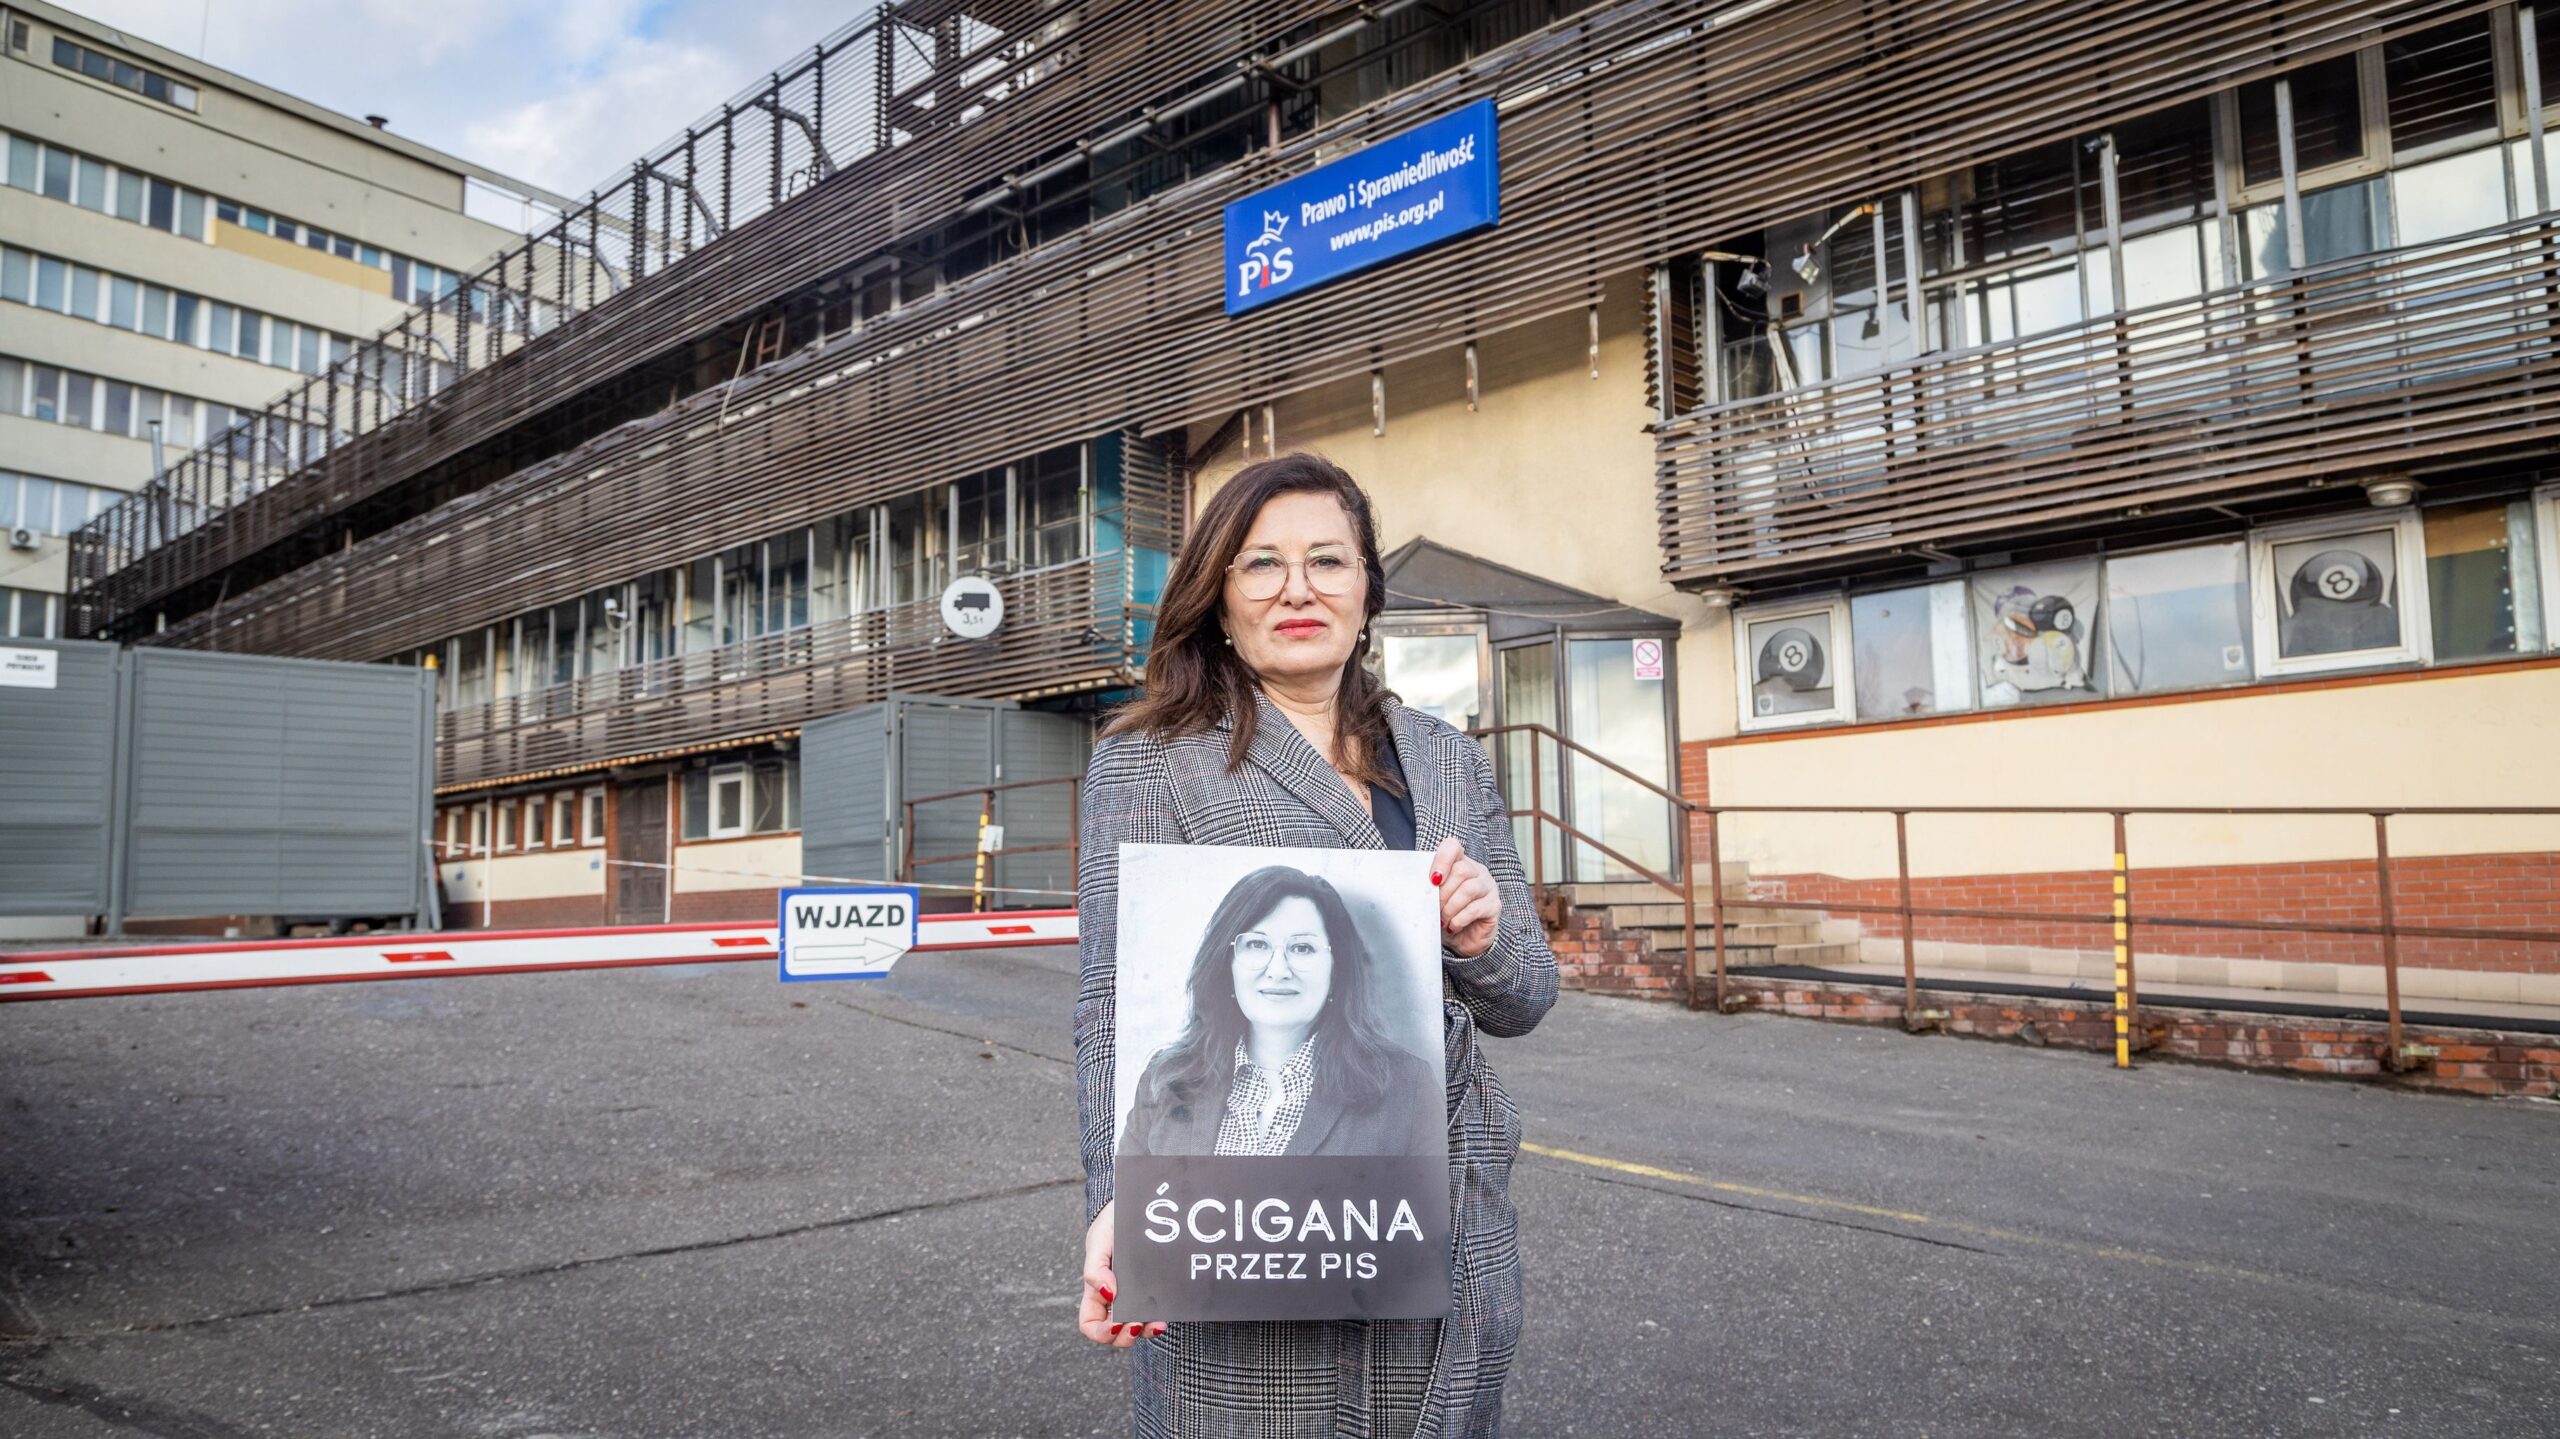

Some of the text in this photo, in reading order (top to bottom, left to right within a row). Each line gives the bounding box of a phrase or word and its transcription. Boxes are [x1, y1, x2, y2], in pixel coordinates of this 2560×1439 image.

[1302, 134, 1475, 227] Prawo i Sprawiedliwość
[1330, 191, 1444, 251] www.pis.org.pl
[795, 905, 905, 928] WJAZD
[1144, 1181, 1425, 1243] ŚCIGANA
[1190, 1252, 1378, 1280] PRZEZ PIS
